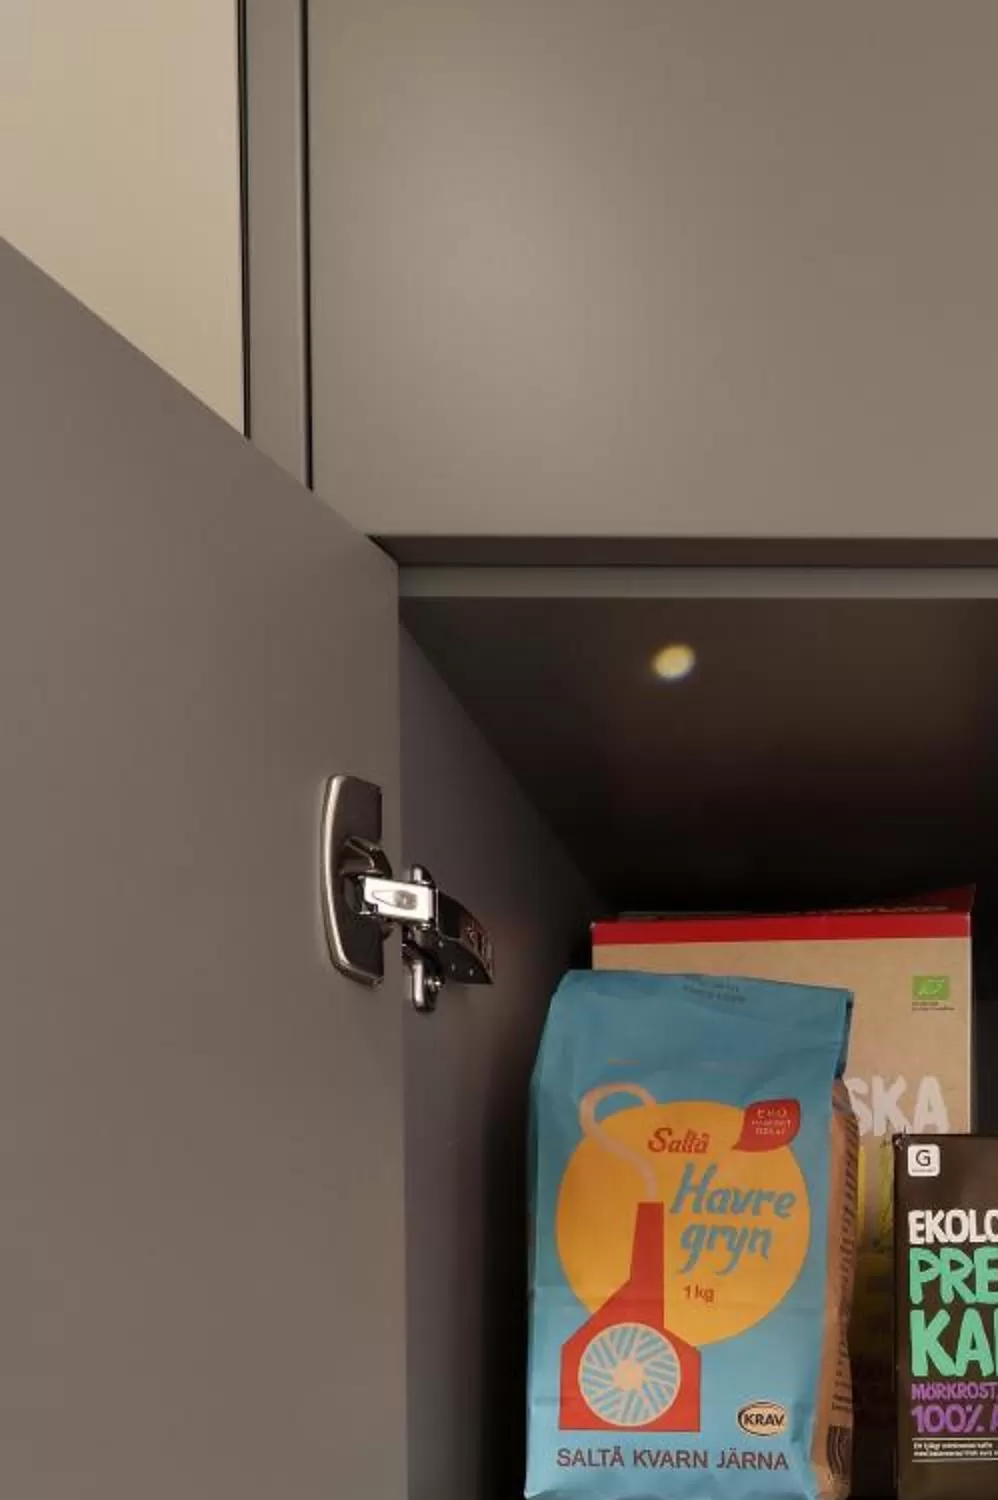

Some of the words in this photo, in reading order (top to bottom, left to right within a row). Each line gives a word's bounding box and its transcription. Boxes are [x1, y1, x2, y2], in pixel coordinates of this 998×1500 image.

[916, 1150, 931, 1166] G
[670, 1161, 797, 1219] Havre
[677, 1223, 773, 1277] gryn
[744, 1411, 785, 1427] KRAV
[911, 1403, 985, 1433] 100%
[556, 1446, 625, 1468] SALTÅ
[633, 1448, 709, 1469] KVARN
[716, 1449, 789, 1471] JÄRNA
